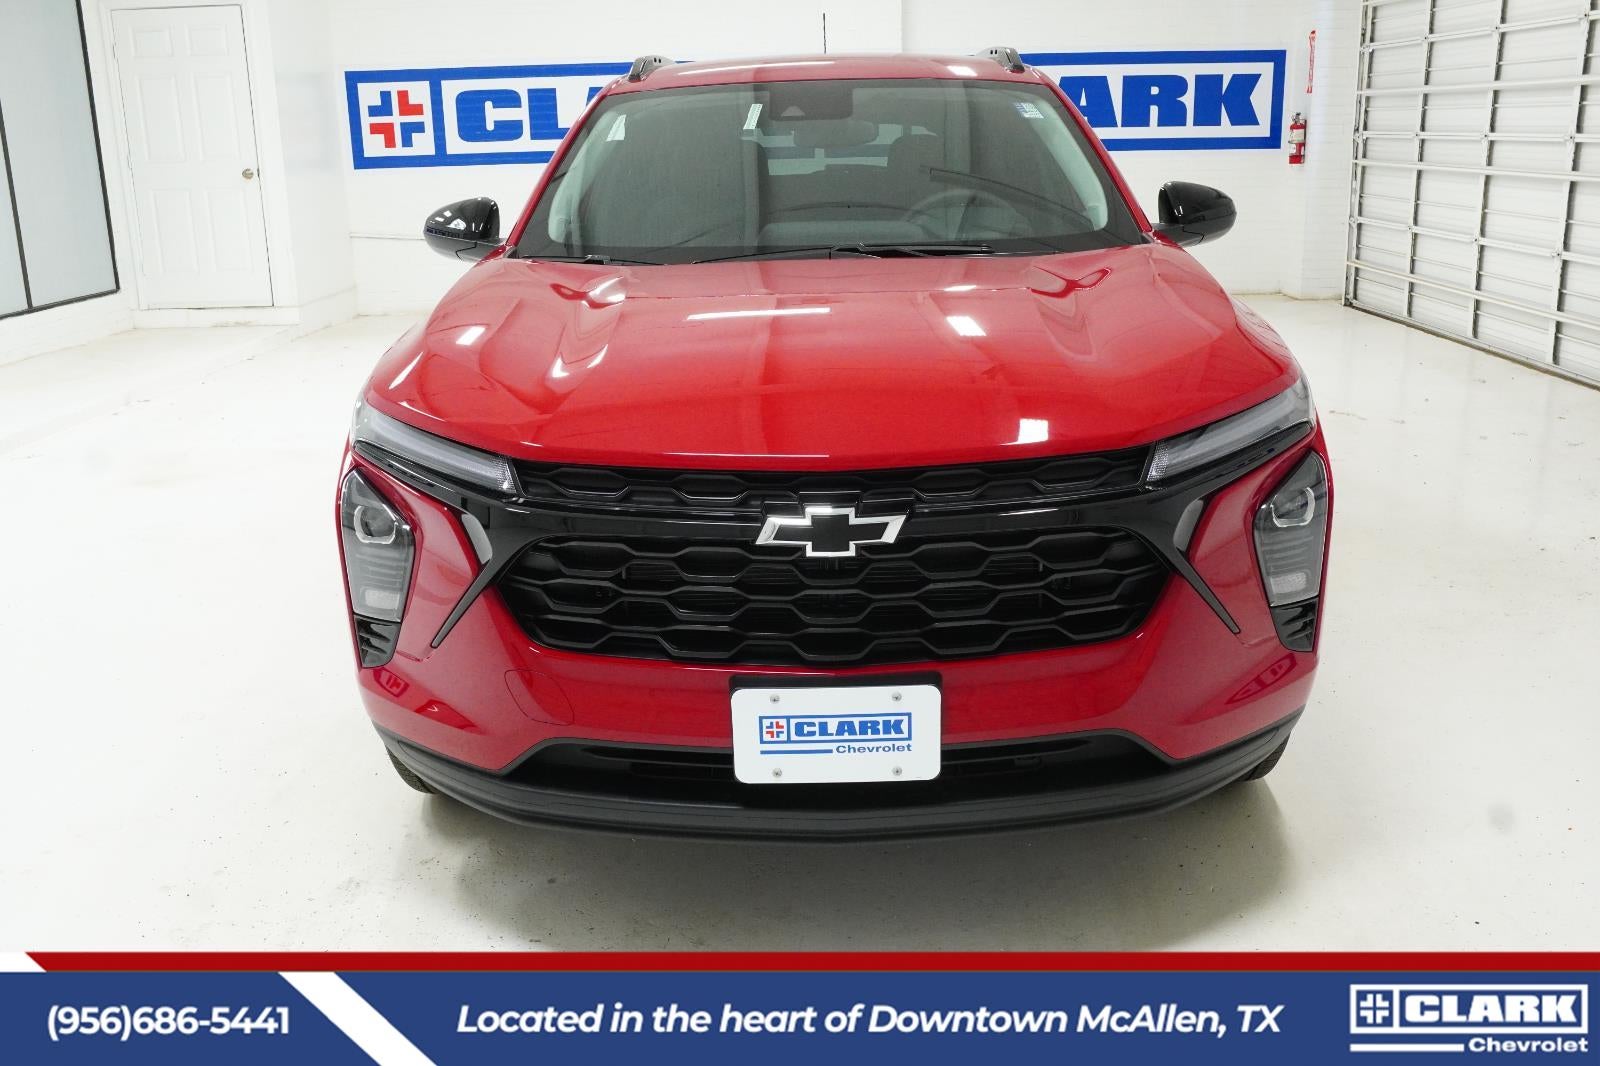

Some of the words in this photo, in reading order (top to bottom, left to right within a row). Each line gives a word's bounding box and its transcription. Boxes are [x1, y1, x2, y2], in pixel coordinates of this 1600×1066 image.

[455, 86, 603, 142] CL
[794, 719, 904, 737] CLARK
[836, 743, 913, 754] Chevrolet
